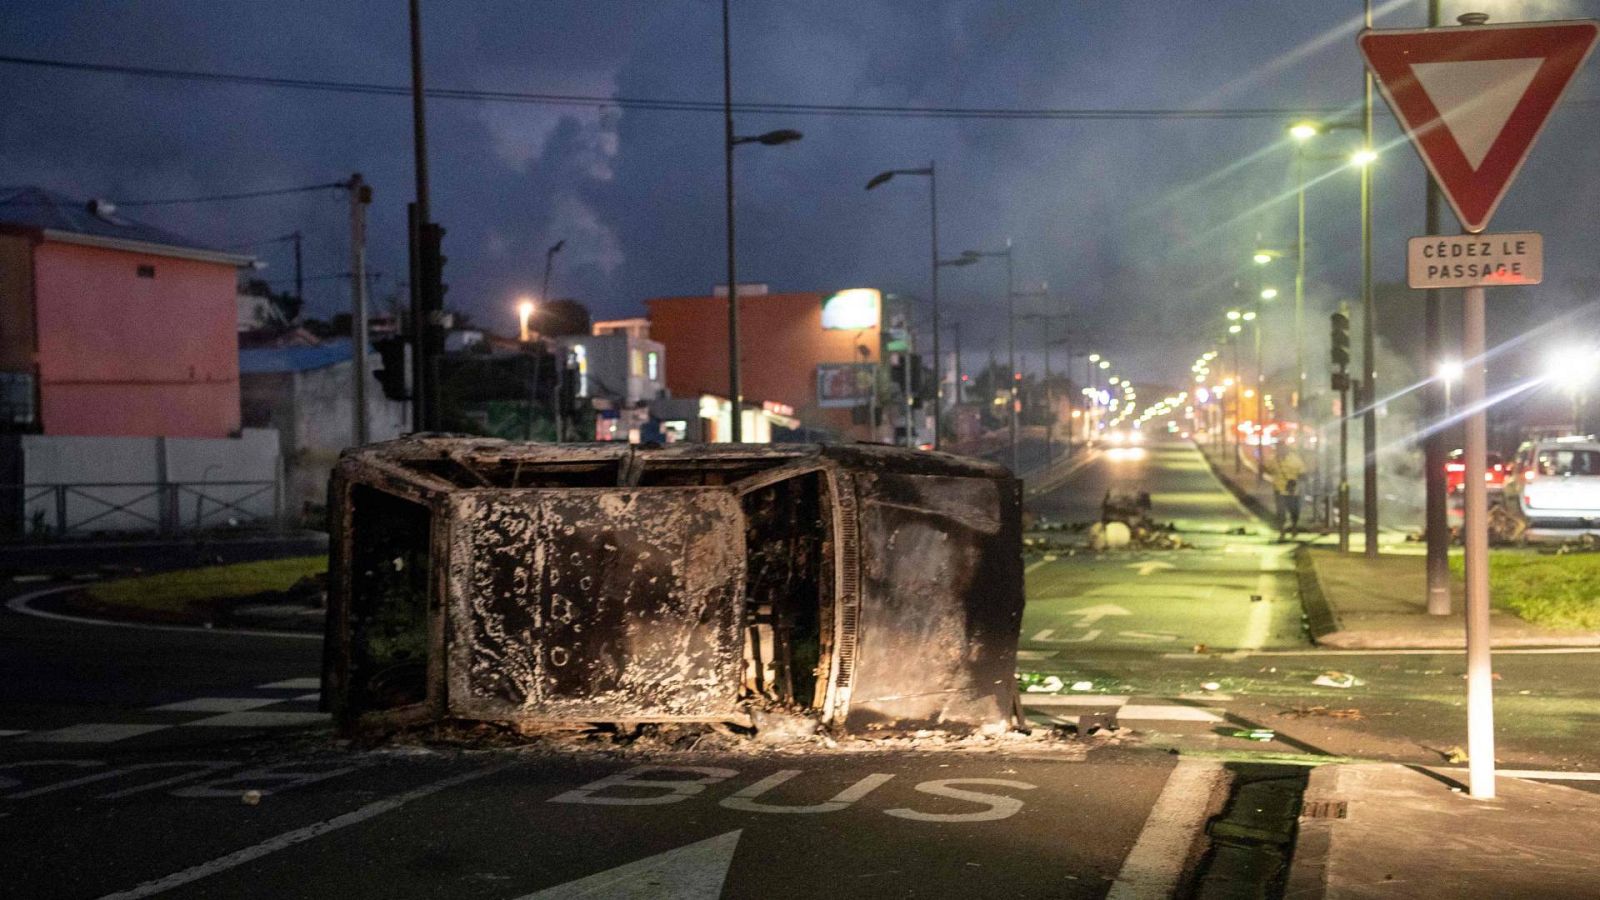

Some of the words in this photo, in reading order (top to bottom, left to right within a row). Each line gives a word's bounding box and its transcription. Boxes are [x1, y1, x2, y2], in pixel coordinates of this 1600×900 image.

[1423, 241, 1491, 258] CÉDEZ
[1504, 241, 1526, 256] LE
[1428, 263, 1522, 279] PASSAGE
[1031, 629, 1181, 642] US
[548, 766, 1038, 822] BUS
